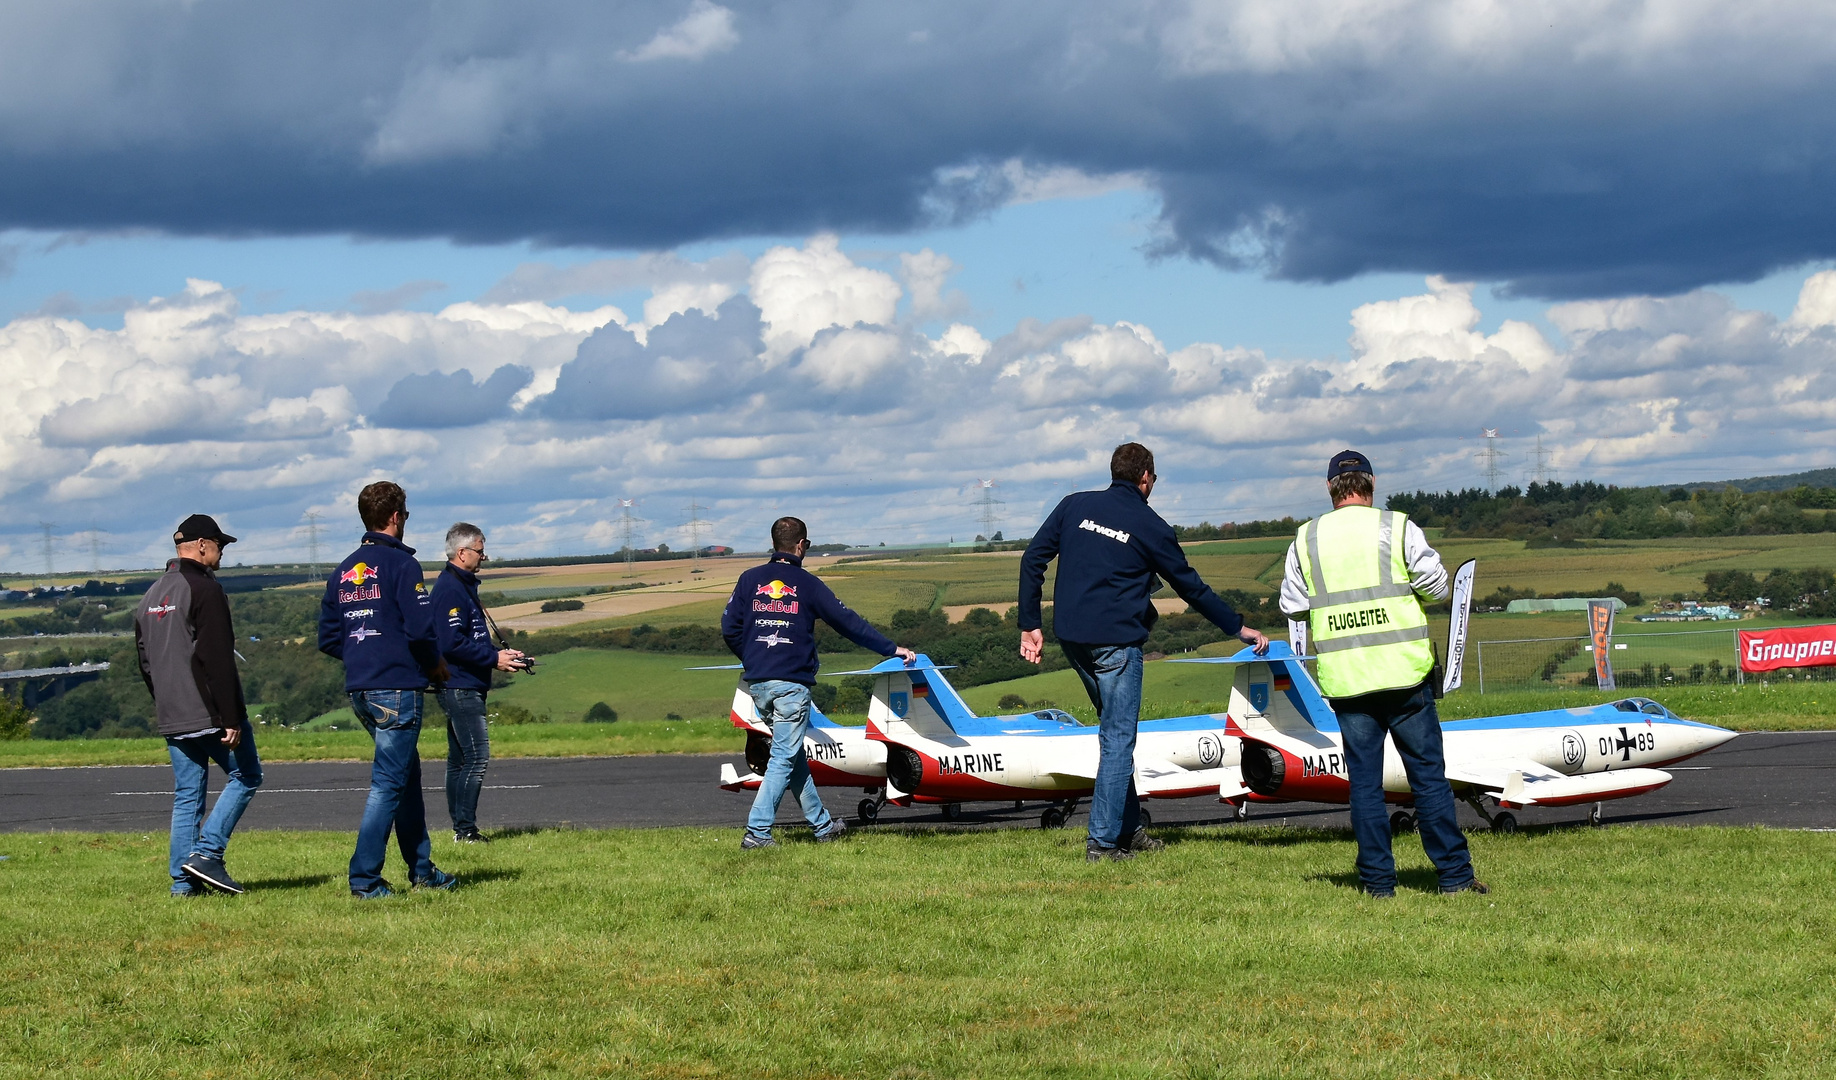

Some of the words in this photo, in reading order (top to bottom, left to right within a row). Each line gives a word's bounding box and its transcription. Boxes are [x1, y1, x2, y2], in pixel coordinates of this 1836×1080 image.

[1078, 519, 1131, 544] Airworld
[1327, 607, 1390, 632] FLUGLEITER
[896, 700, 902, 710] 2
[1256, 693, 1262, 703] 2
[805, 742, 846, 761] ARINE
[1599, 737, 1614, 756] 01
[1638, 732, 1655, 752] 89
[938, 753, 1004, 775] MARINE
[1302, 753, 1349, 777] MARI
